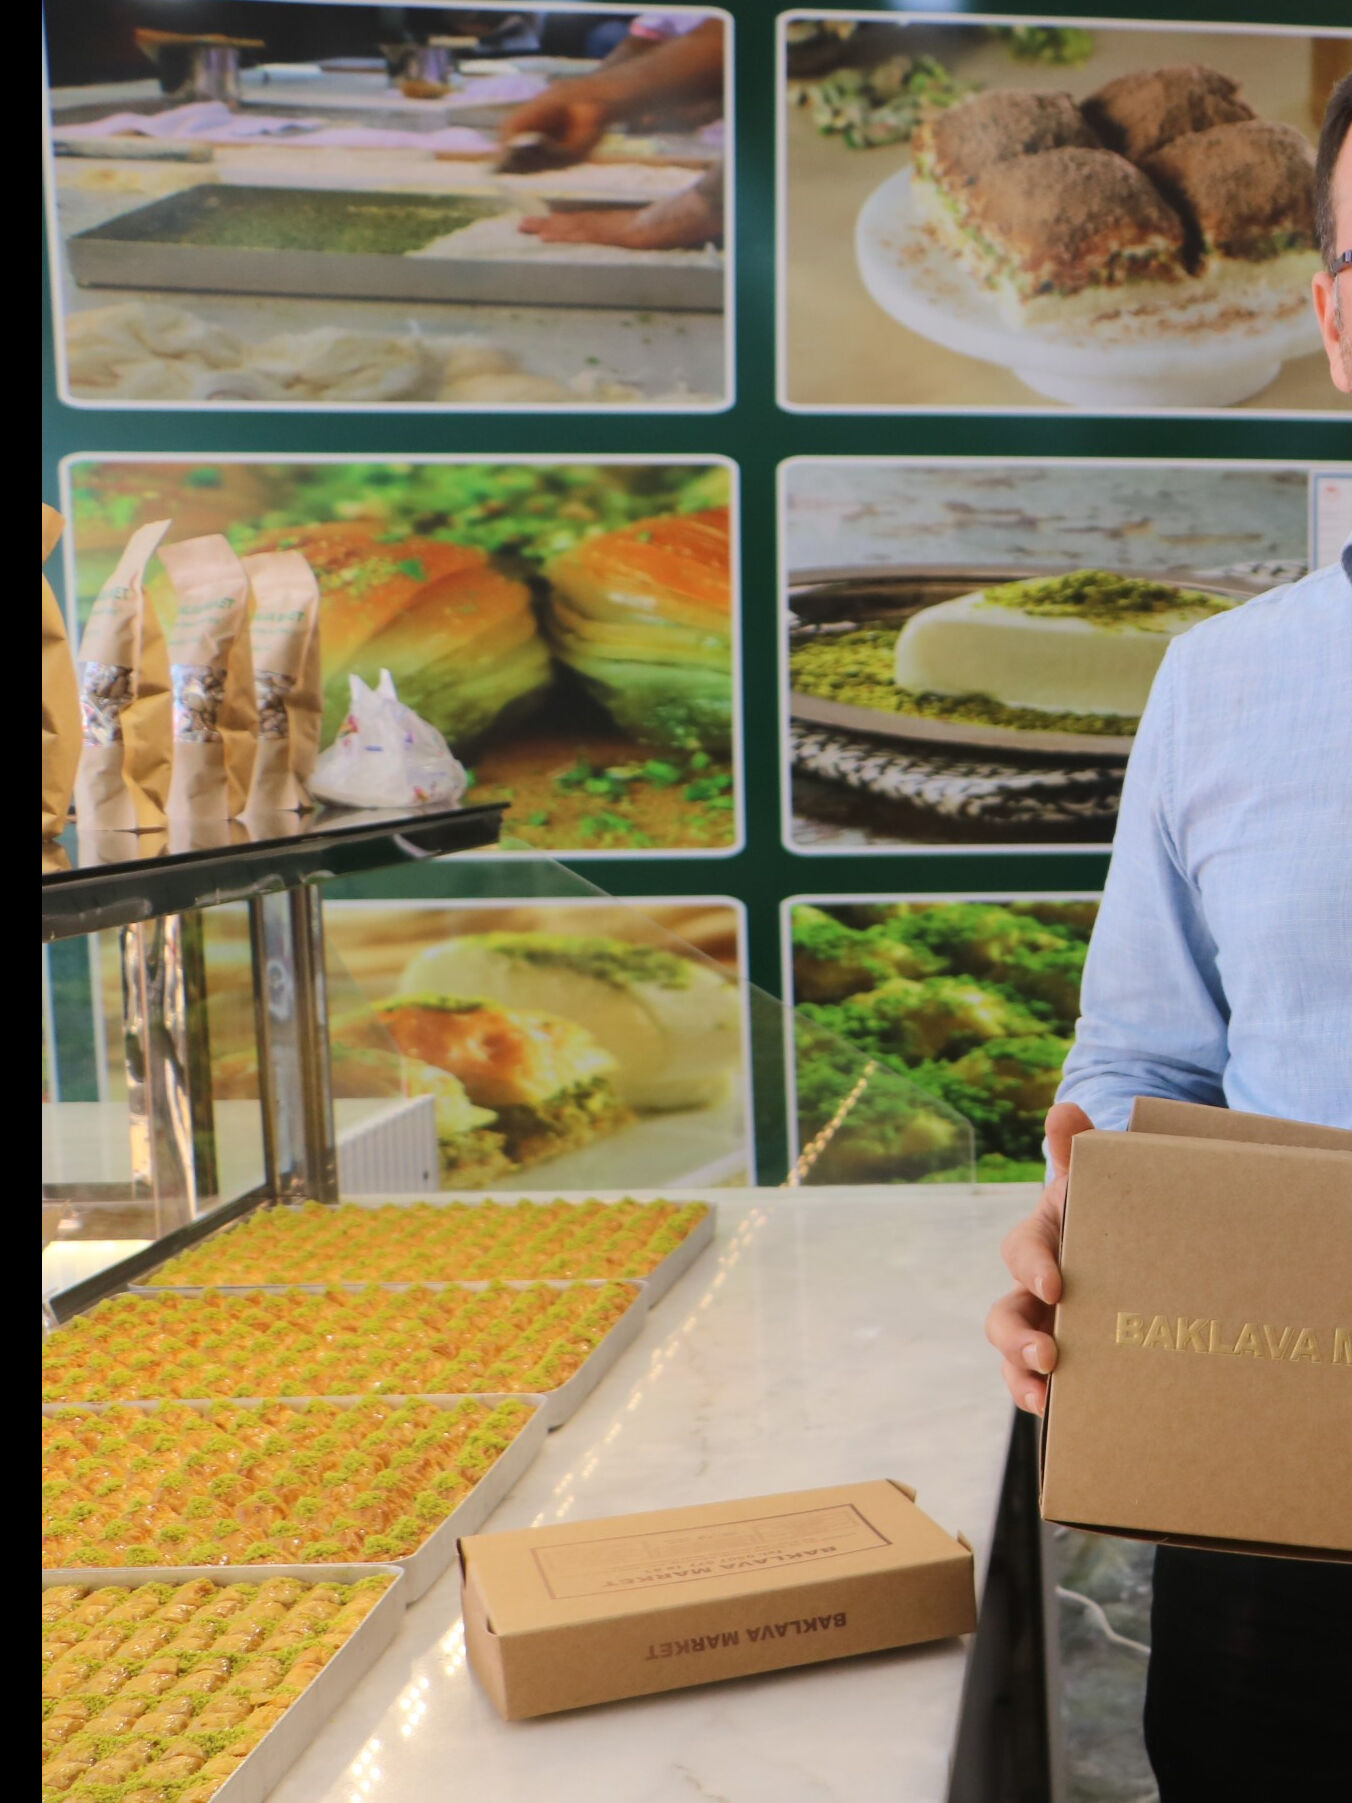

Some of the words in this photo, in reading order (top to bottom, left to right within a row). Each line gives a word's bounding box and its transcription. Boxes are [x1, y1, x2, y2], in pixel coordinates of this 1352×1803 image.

[1115, 1311, 1322, 1364] BAKLAVA
[747, 1612, 847, 1643] BAKLAVA
[644, 1632, 740, 1660] MARKET
